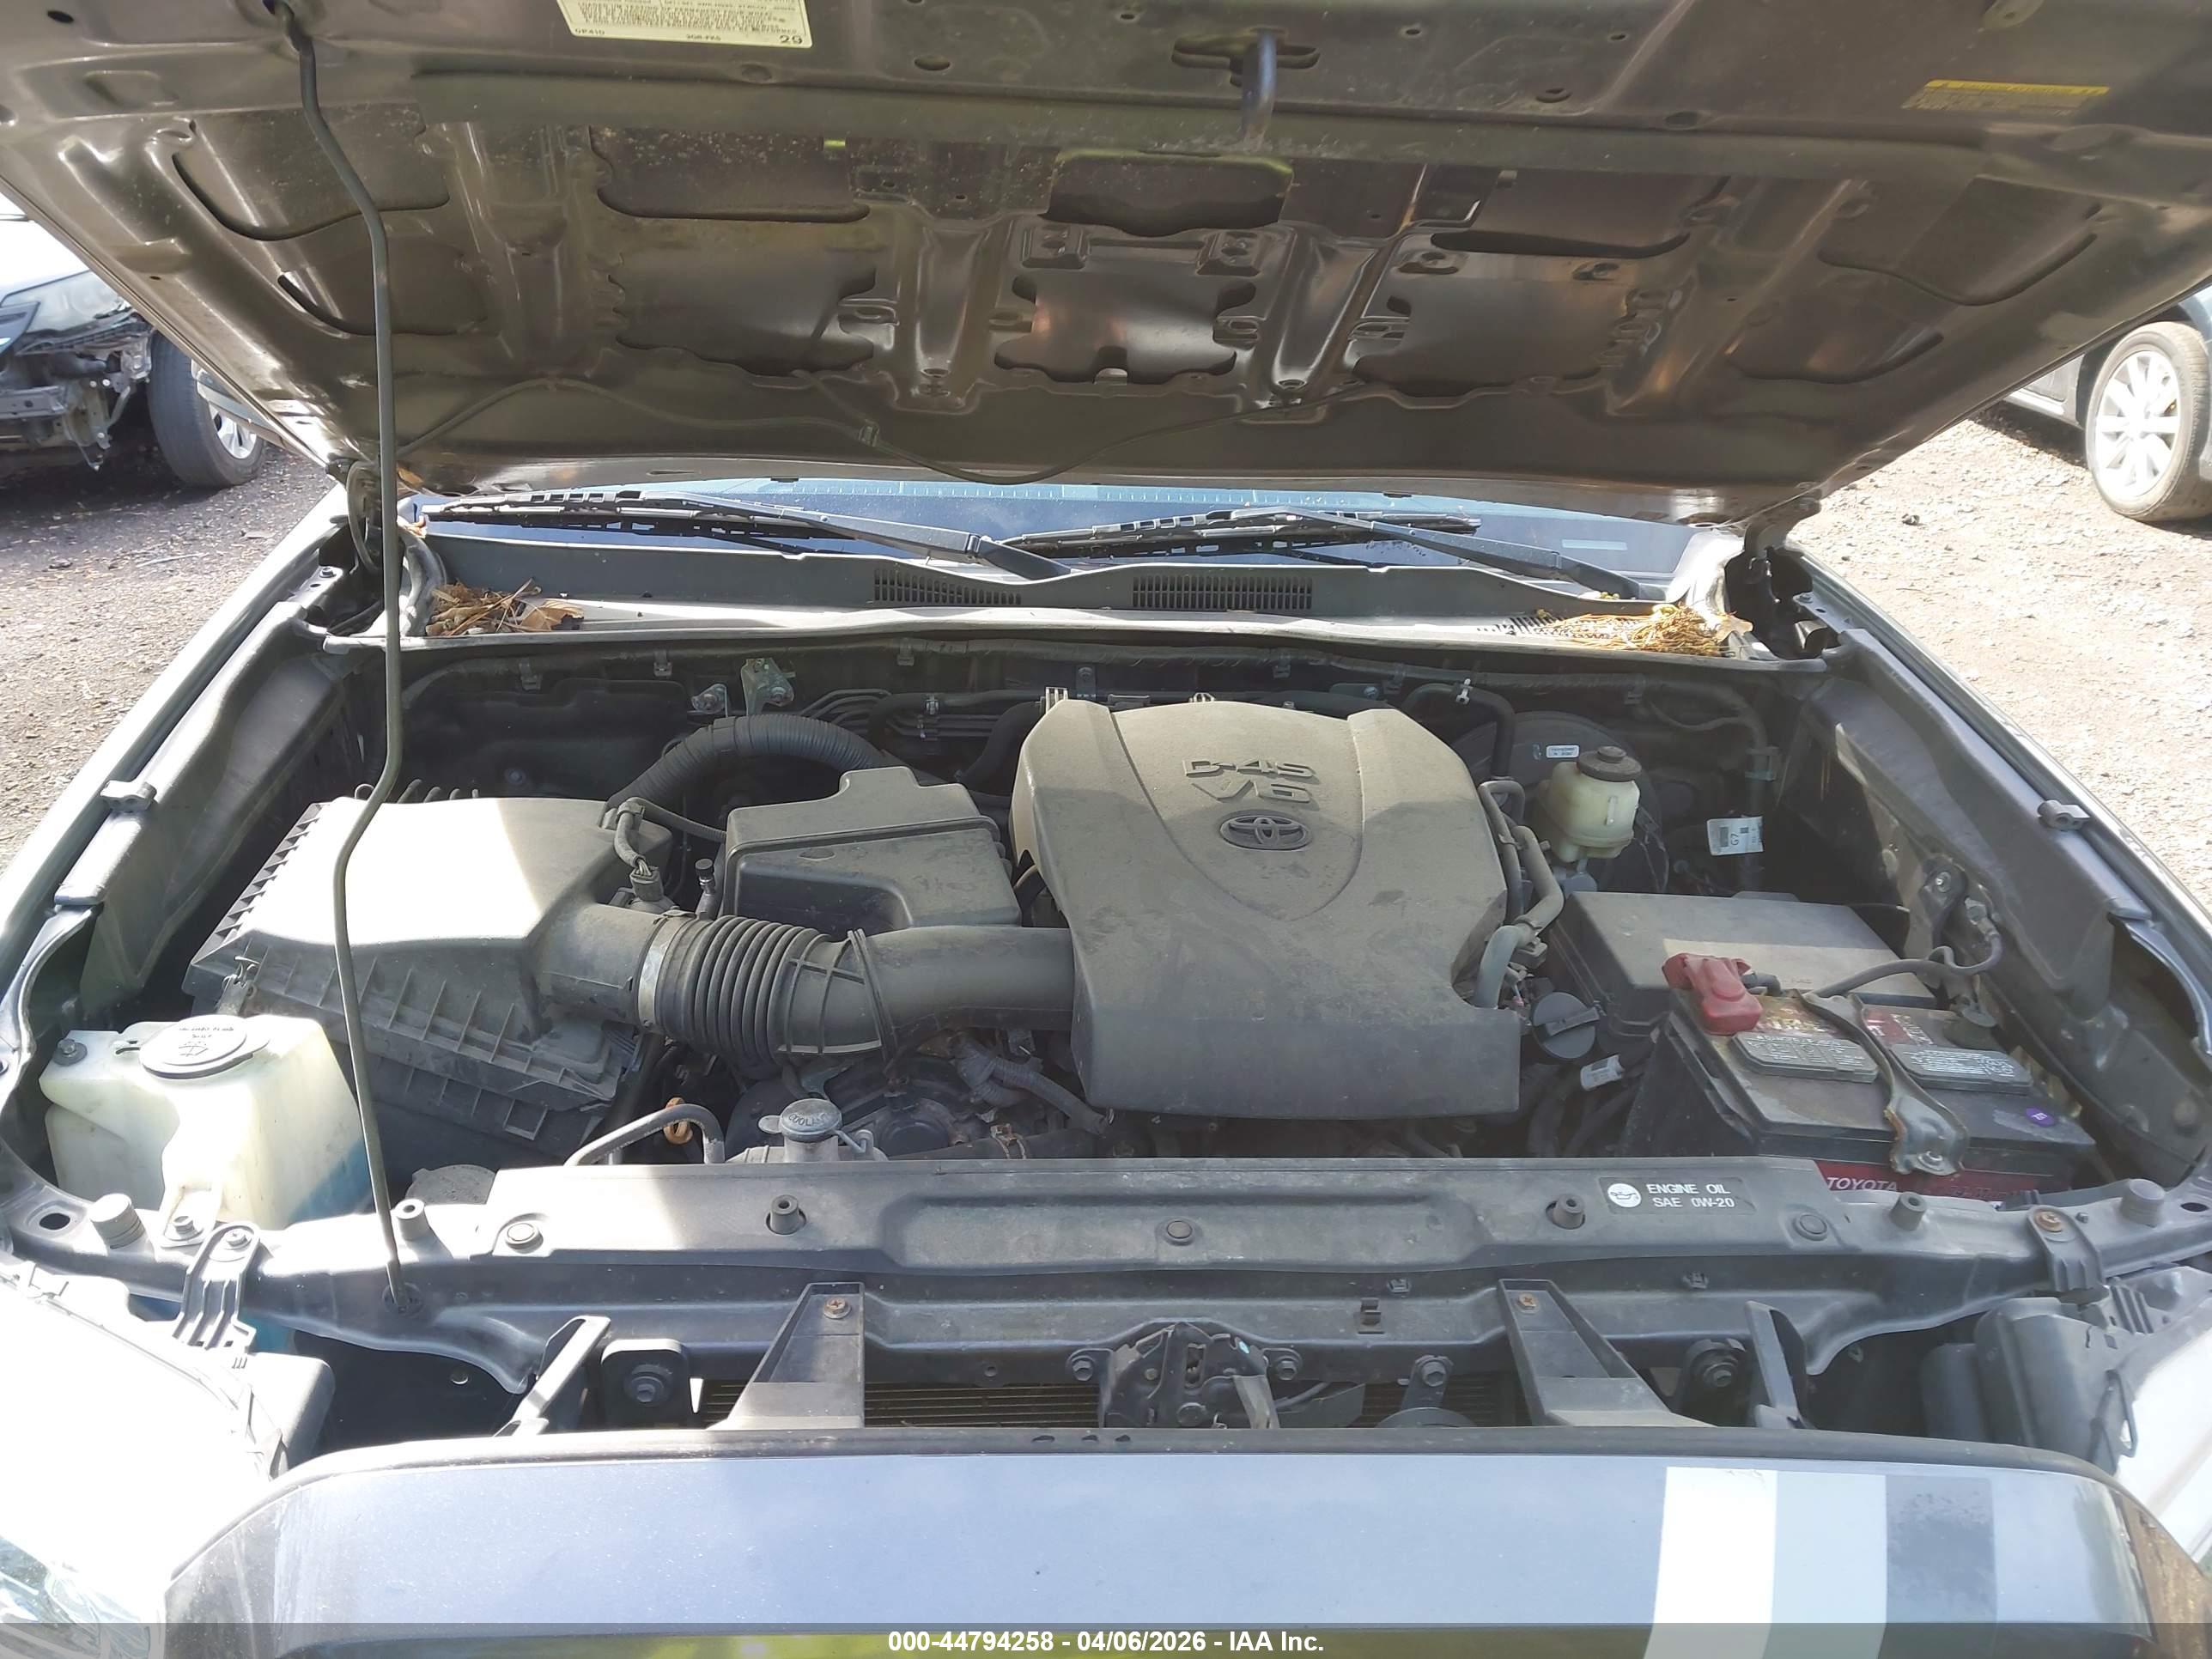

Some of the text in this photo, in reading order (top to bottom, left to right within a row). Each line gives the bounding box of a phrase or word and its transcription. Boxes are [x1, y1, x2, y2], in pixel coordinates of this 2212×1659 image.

[779, 34, 804, 45] 29
[1181, 758, 1317, 779] D-4S
[1191, 779, 1315, 805] V6
[1645, 1183, 1732, 1194] ENGINE OIL
[1826, 1177, 1898, 1192] TOYOTA
[1653, 1197, 1735, 1208] SAE 0W-20
